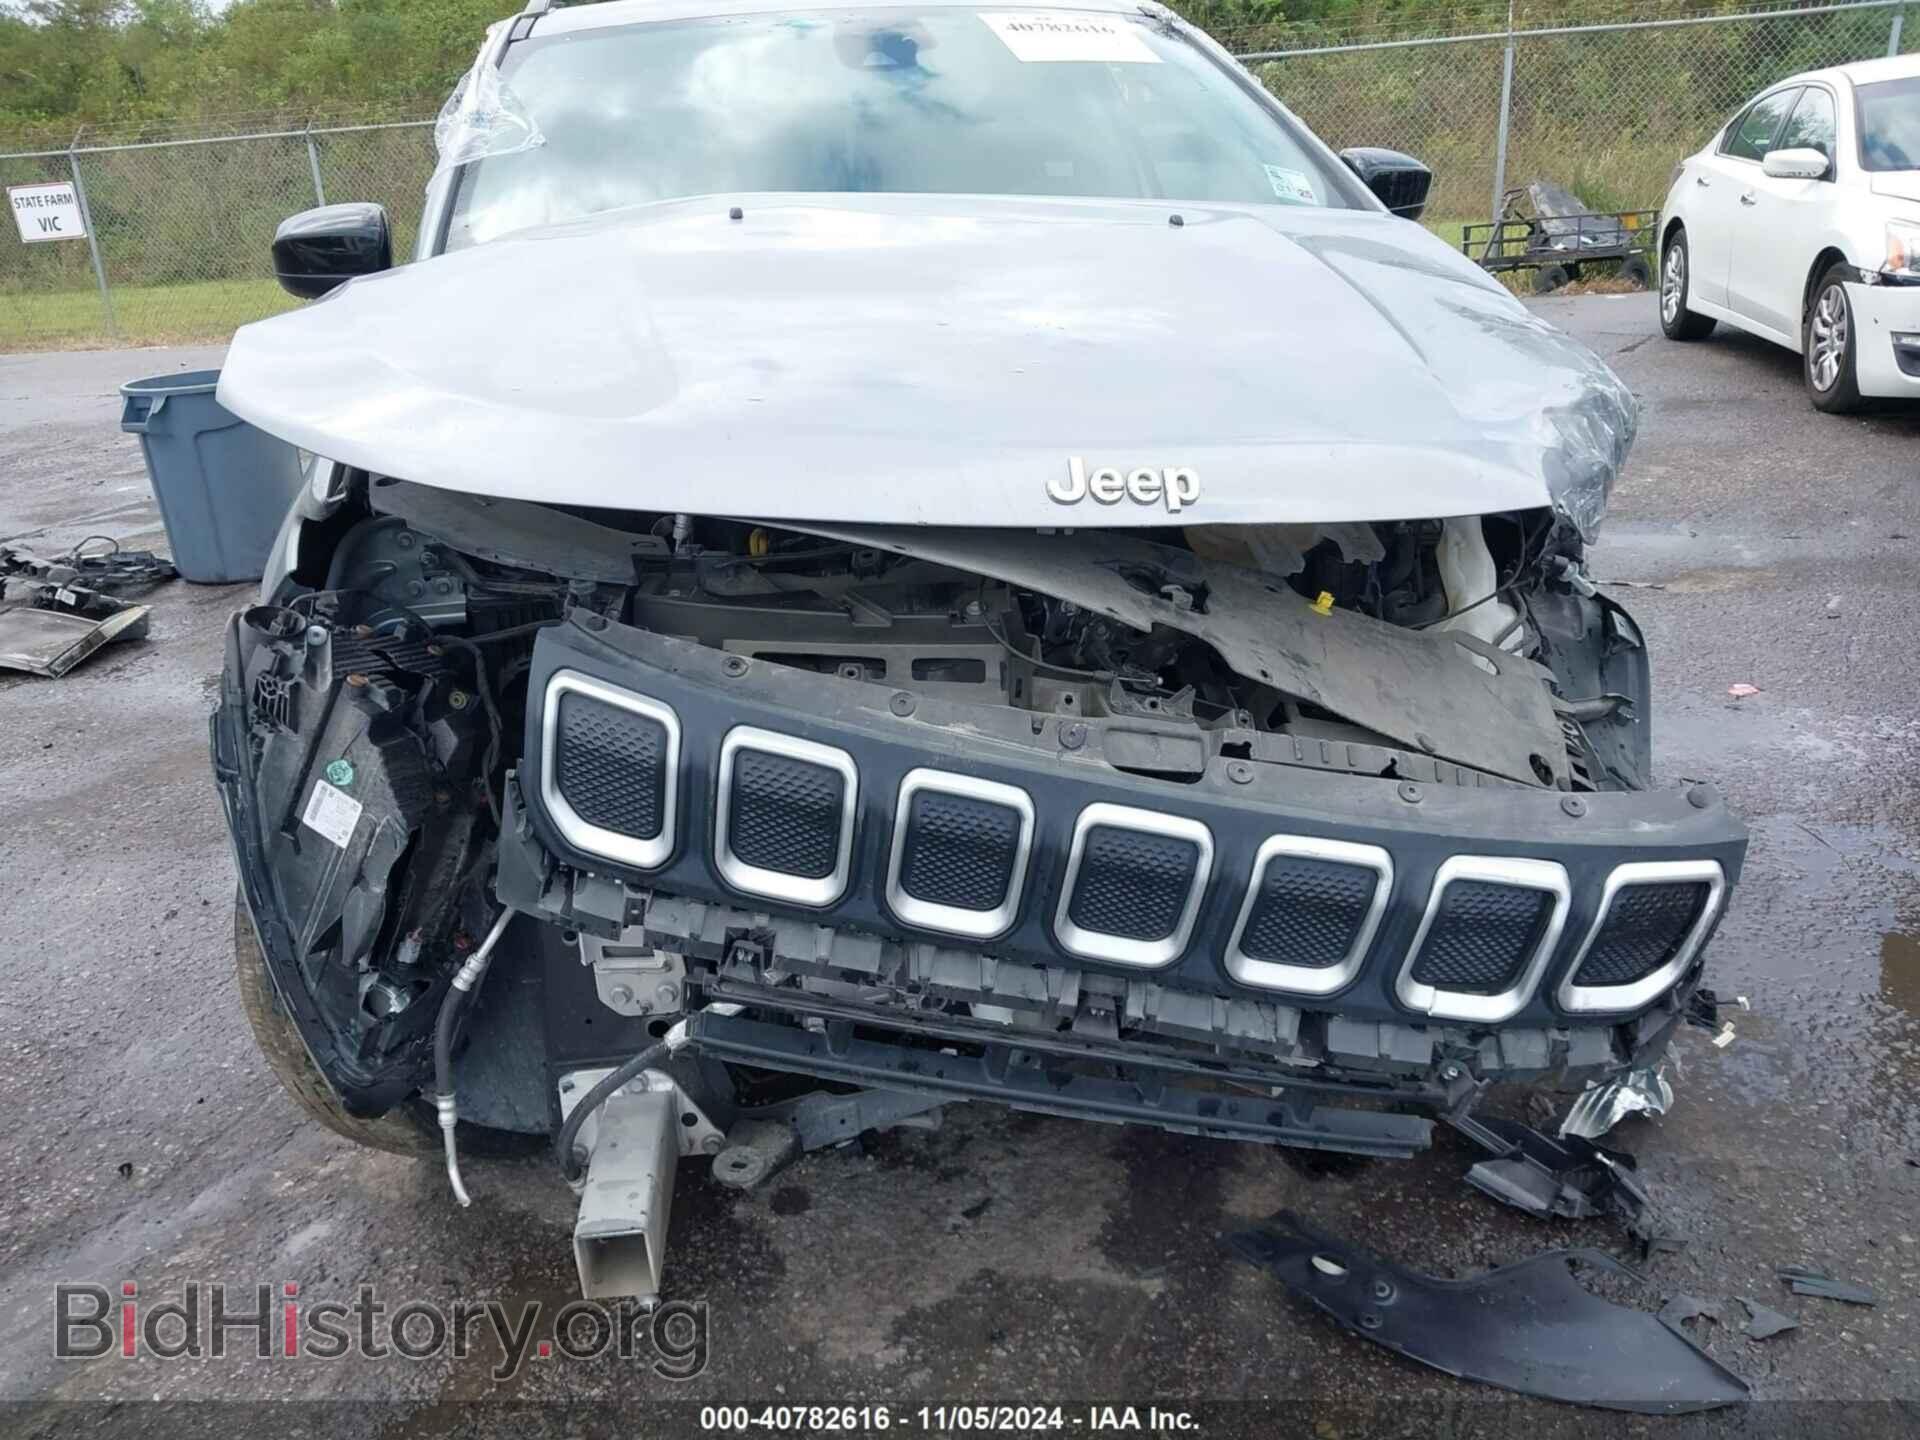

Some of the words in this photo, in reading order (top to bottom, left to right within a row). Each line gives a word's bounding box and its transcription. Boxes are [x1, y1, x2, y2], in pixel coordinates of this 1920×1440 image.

[14, 195, 44, 209] STATE
[44, 193, 73, 207] FARM
[37, 216, 63, 232] VIC
[1046, 456, 1200, 514] Jeep
